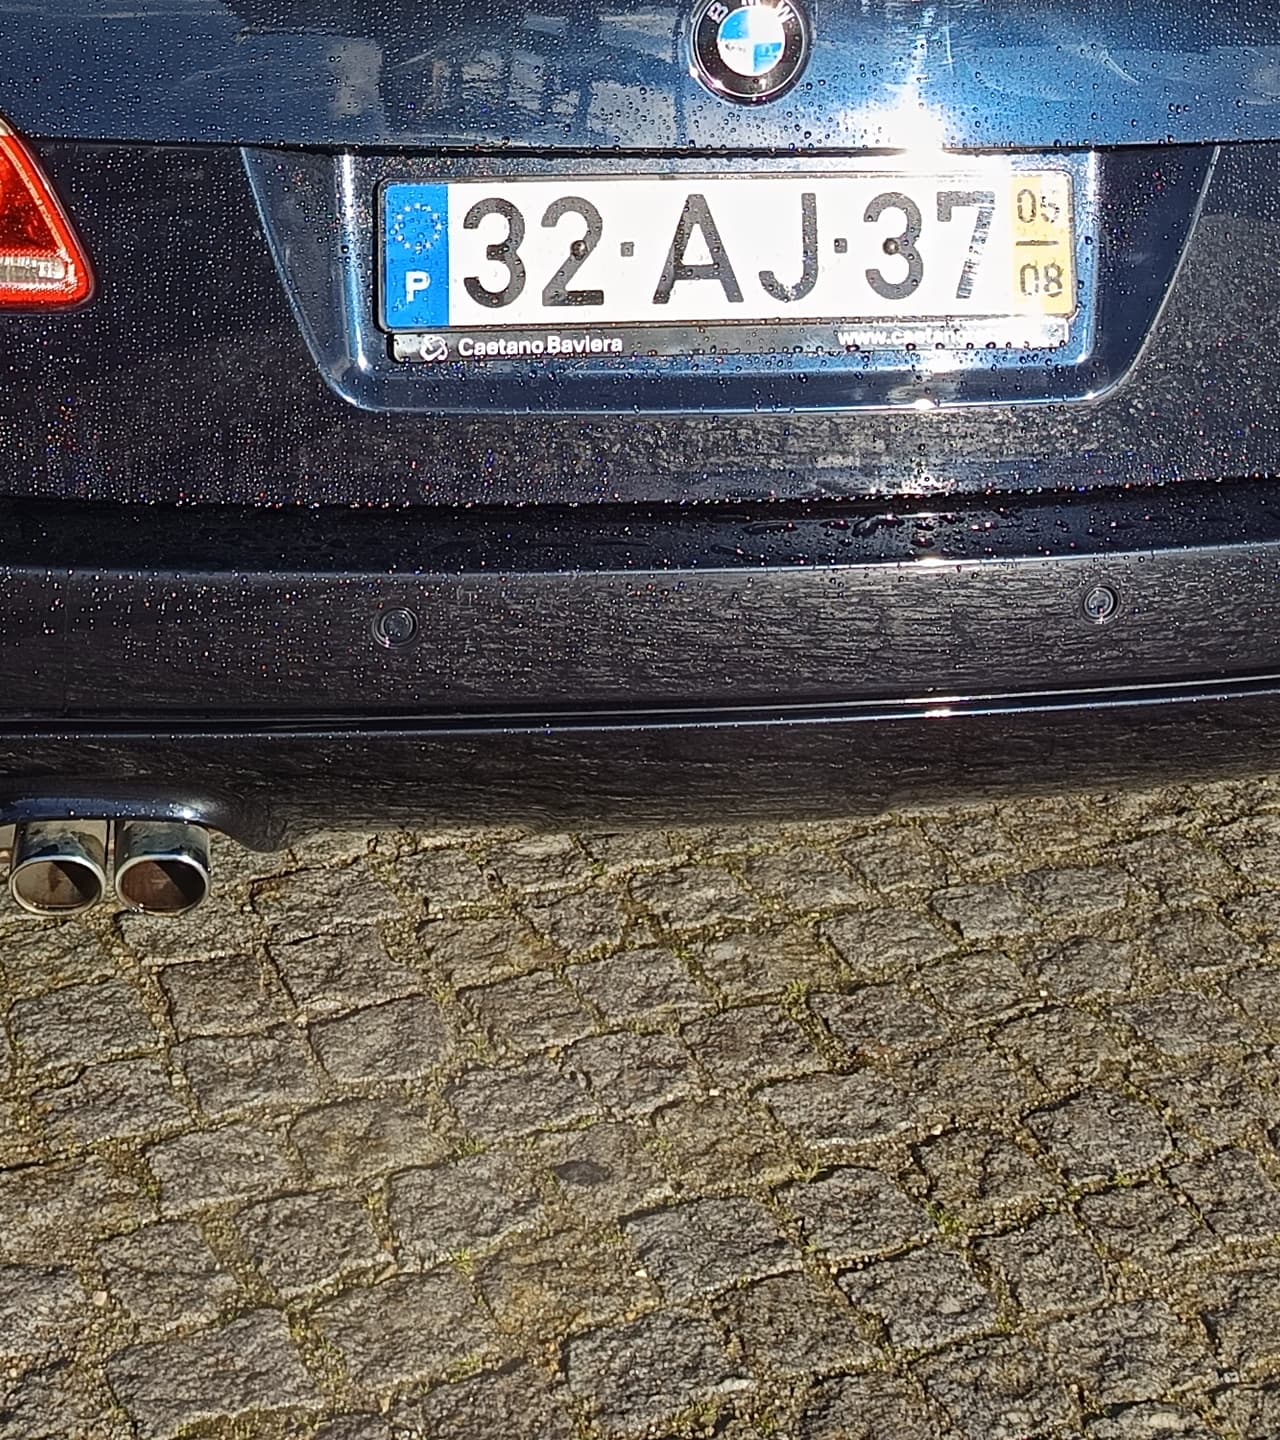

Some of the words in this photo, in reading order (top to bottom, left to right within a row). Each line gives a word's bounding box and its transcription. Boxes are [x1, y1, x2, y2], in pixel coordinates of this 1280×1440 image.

[1017, 188, 1060, 223] 05
[404, 269, 432, 304] P
[1020, 263, 1063, 298] 08
